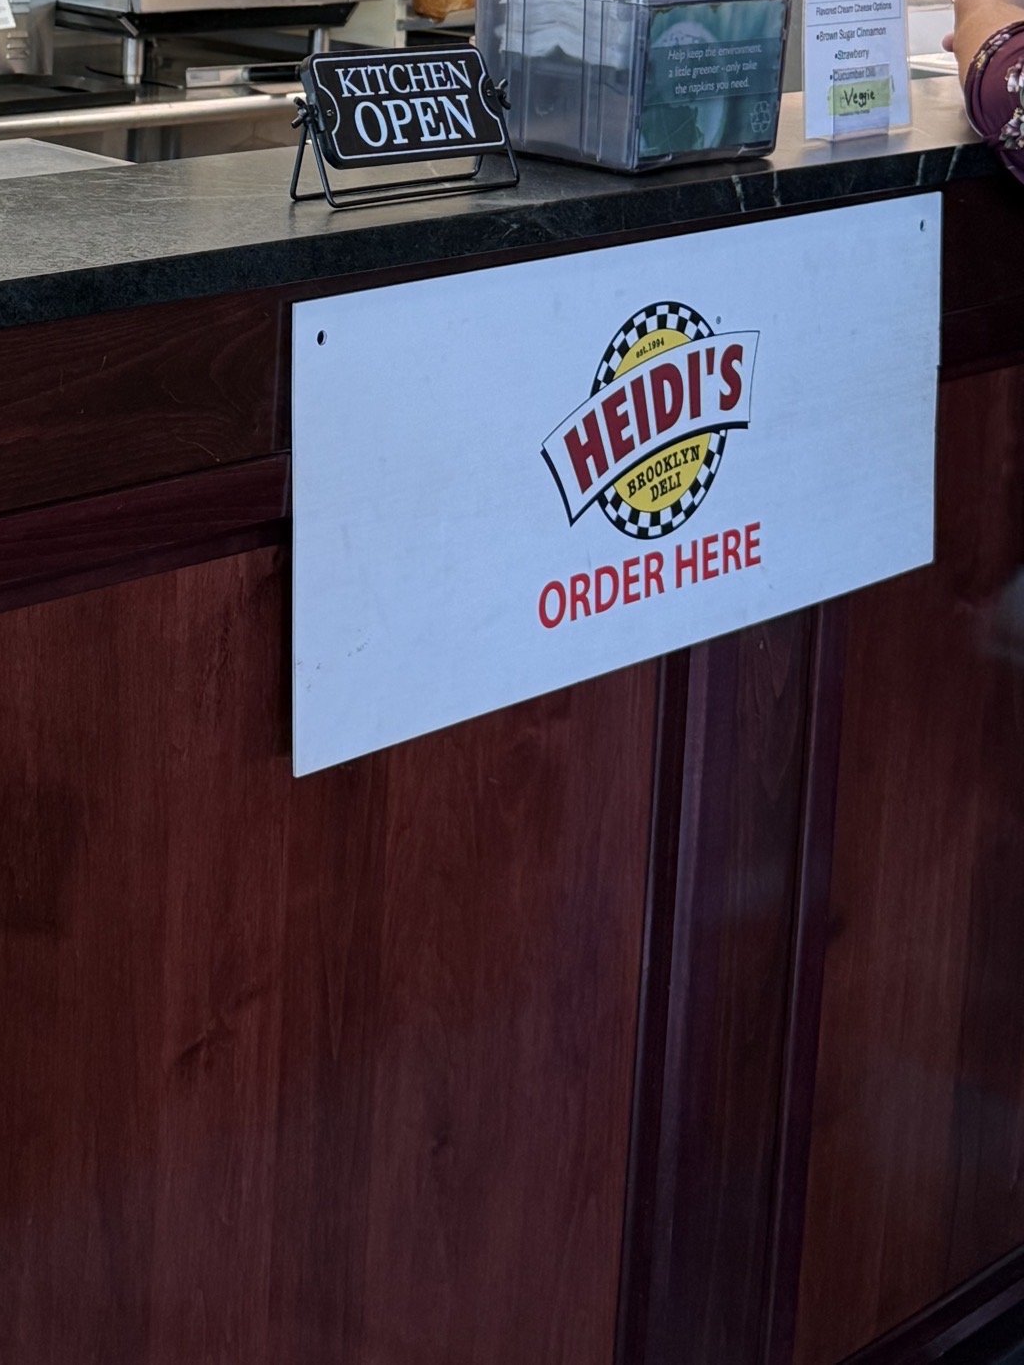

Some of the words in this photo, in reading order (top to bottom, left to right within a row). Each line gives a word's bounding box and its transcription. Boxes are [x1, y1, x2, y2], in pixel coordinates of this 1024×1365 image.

[816, 6, 837, 16] Flavored
[837, 5, 854, 14] Cream
[854, 3, 872, 13] Cheese
[872, 1, 892, 12] Options
[819, 31, 838, 41] Brown
[839, 29, 855, 41] Sugar
[856, 26, 887, 38] Cinnamon
[667, 50, 686, 64] Help
[686, 49, 703, 62] keep
[705, 47, 716, 57] the
[838, 48, 869, 60] Strawberry
[335, 60, 472, 97] KITCHEN
[675, 65, 691, 77] little
[692, 65, 720, 79] greener
[726, 60, 741, 74] only
[742, 60, 758, 71] take
[675, 82, 687, 94] the
[689, 81, 714, 95] napkins
[716, 82, 729, 93] you
[844, 87, 875, 107] Veggie
[354, 94, 476, 148] OPEN
[563, 343, 744, 495] HEIDI'S
[626, 443, 701, 499] BROOKLYN
[649, 471, 682, 503] DELI
[538, 550, 665, 629] ORDER
[675, 521, 762, 589] HERE
